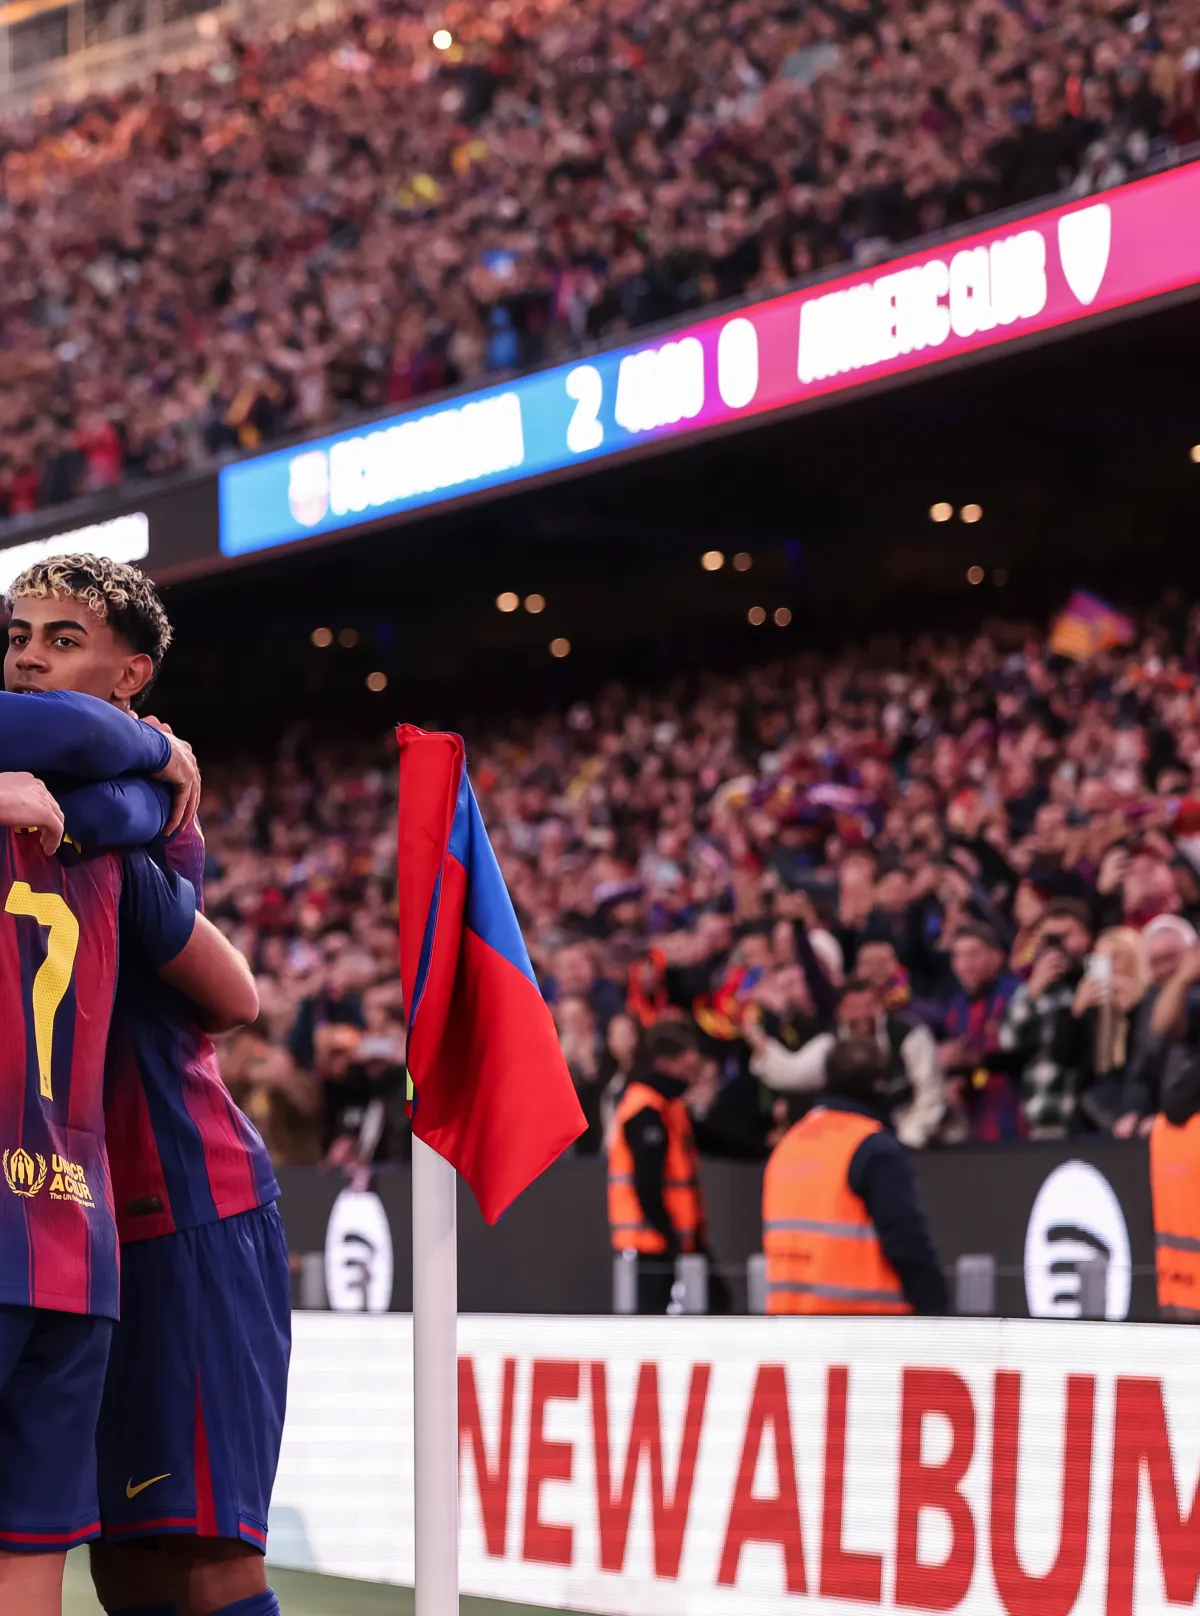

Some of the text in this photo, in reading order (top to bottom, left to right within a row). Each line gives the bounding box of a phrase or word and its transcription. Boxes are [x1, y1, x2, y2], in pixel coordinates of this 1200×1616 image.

[567, 364, 604, 454] 2
[4, 880, 80, 1102] 7
[457, 1356, 711, 1582] NEW
